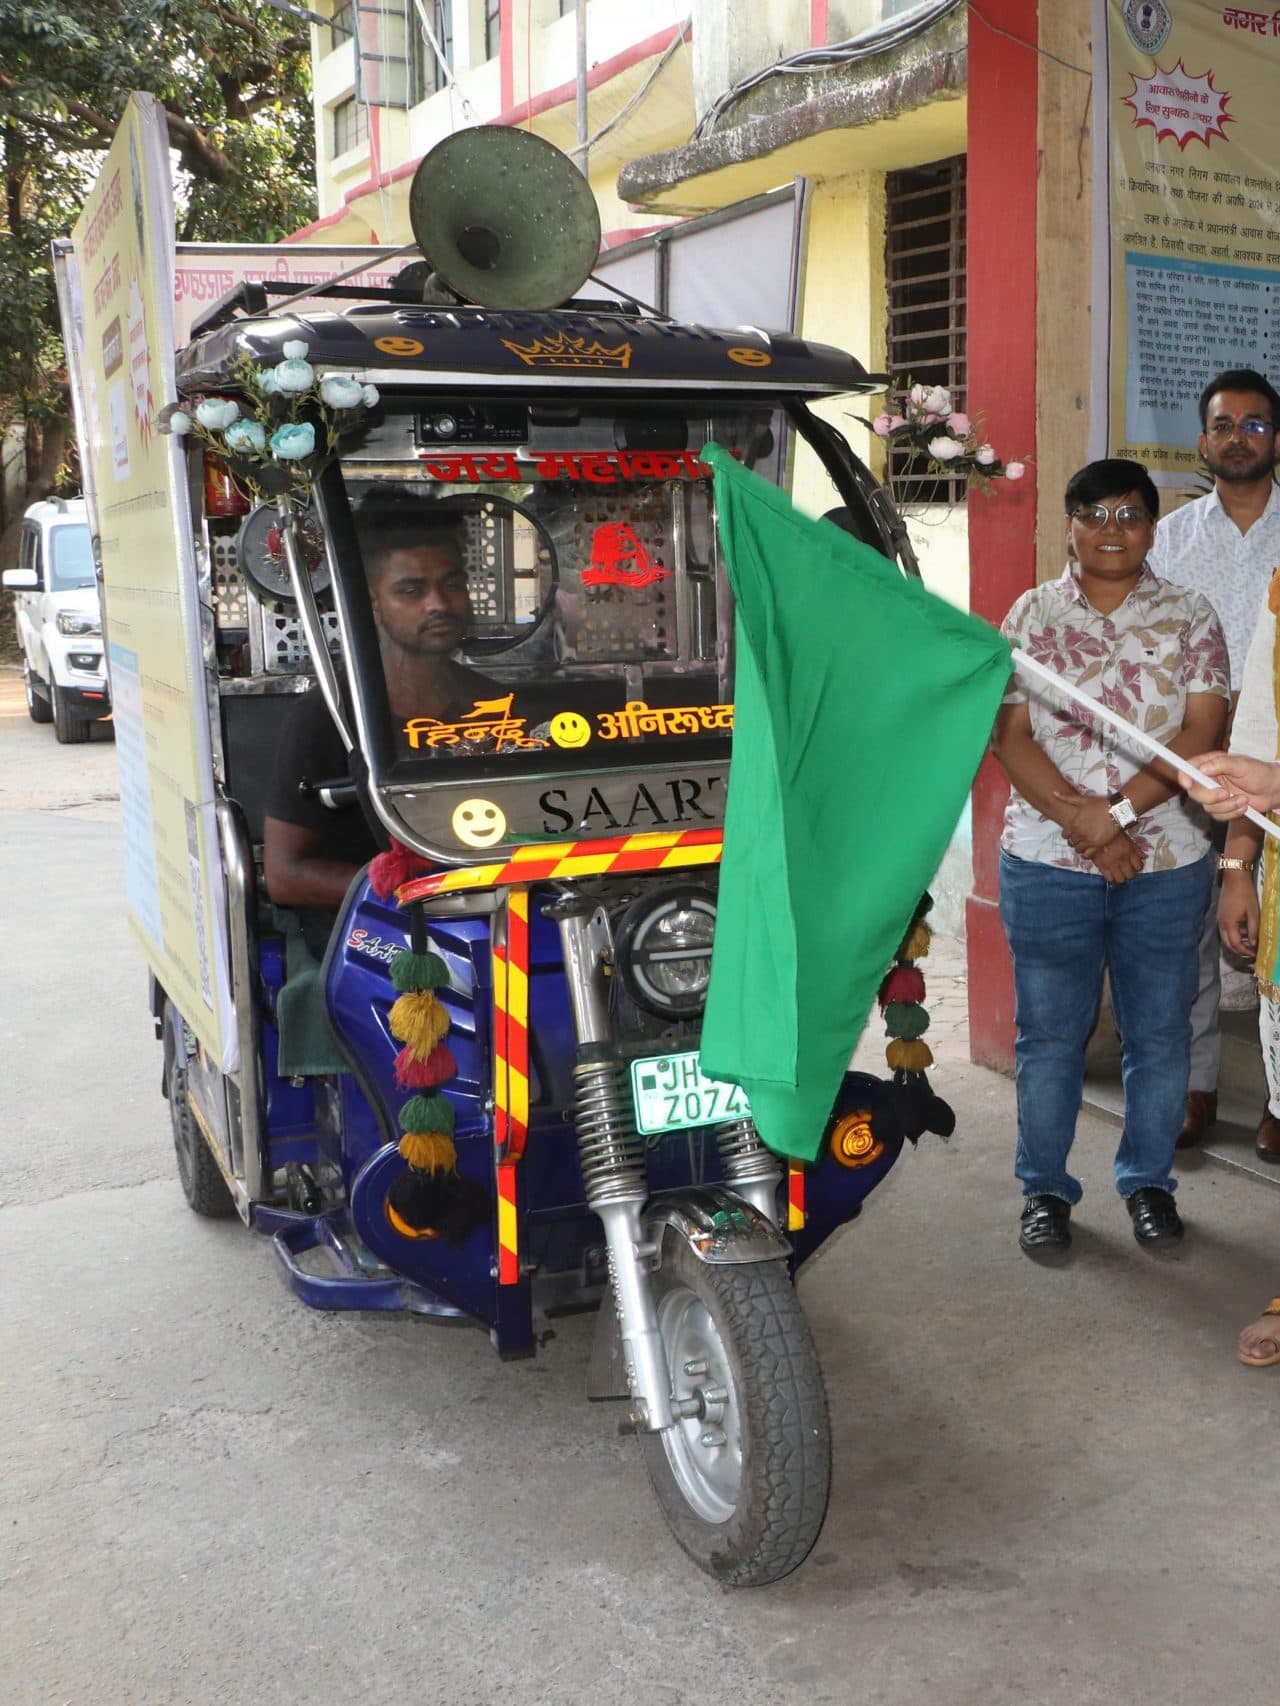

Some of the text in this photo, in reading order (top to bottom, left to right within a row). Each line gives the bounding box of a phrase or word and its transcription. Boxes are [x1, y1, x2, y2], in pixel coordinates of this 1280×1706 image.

[1223, 8, 1268, 35] नगर
[417, 452, 522, 483] जय
[663, 1084, 752, 1126] Z074
